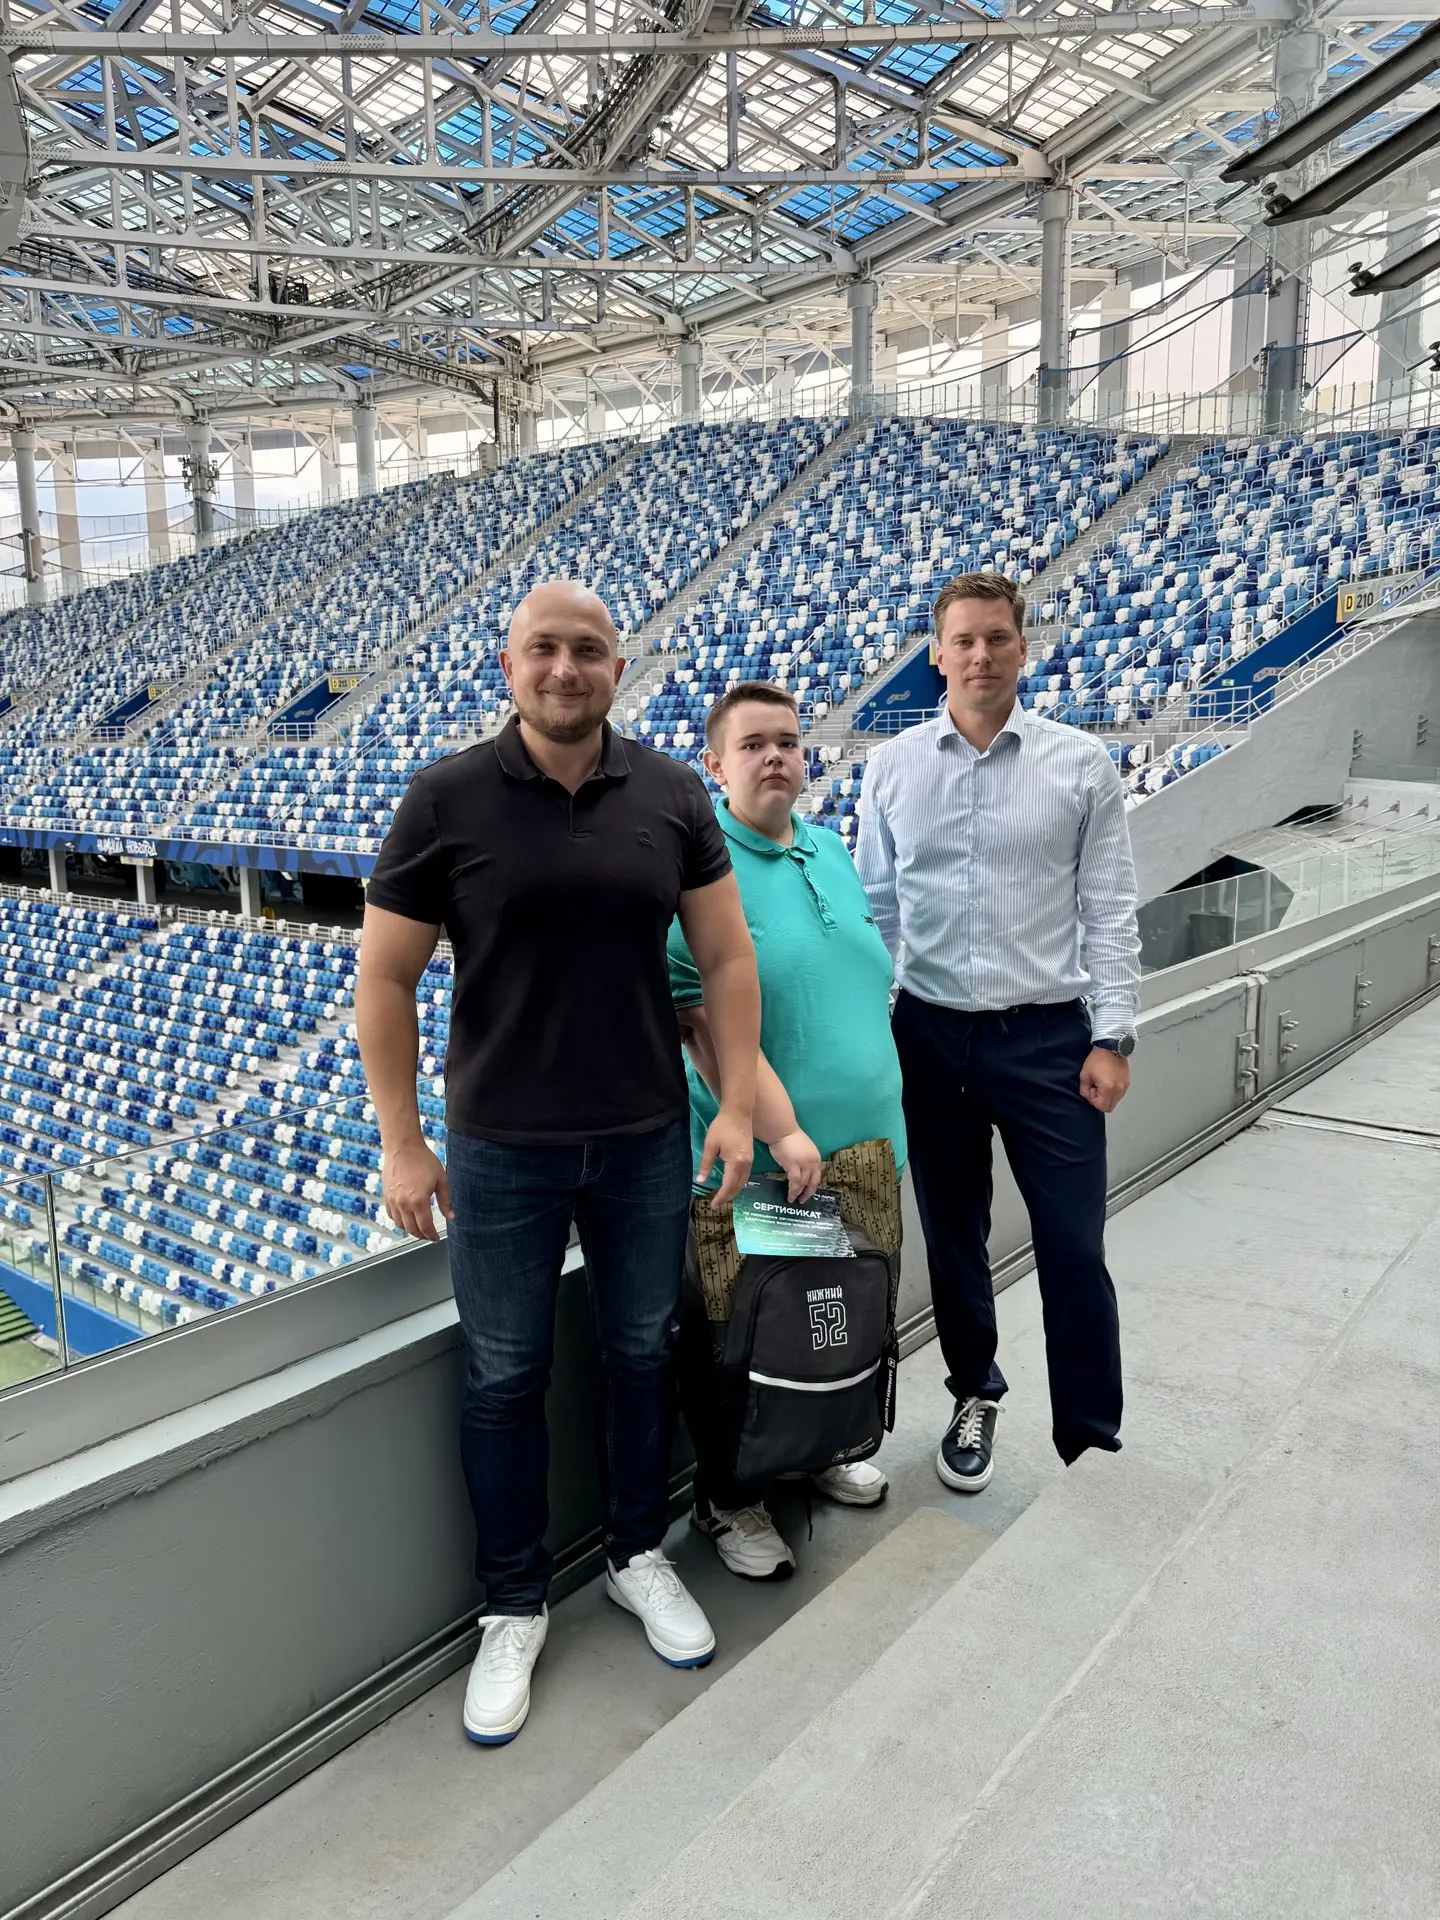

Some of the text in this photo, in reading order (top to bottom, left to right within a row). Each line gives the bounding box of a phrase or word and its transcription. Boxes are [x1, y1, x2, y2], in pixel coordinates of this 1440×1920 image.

[1346, 591, 1374, 610] D 210
[753, 1201, 822, 1219] СЕРТИФИКАТ
[806, 1284, 843, 1303] НИЖНИЙ
[808, 1301, 848, 1350] 52
